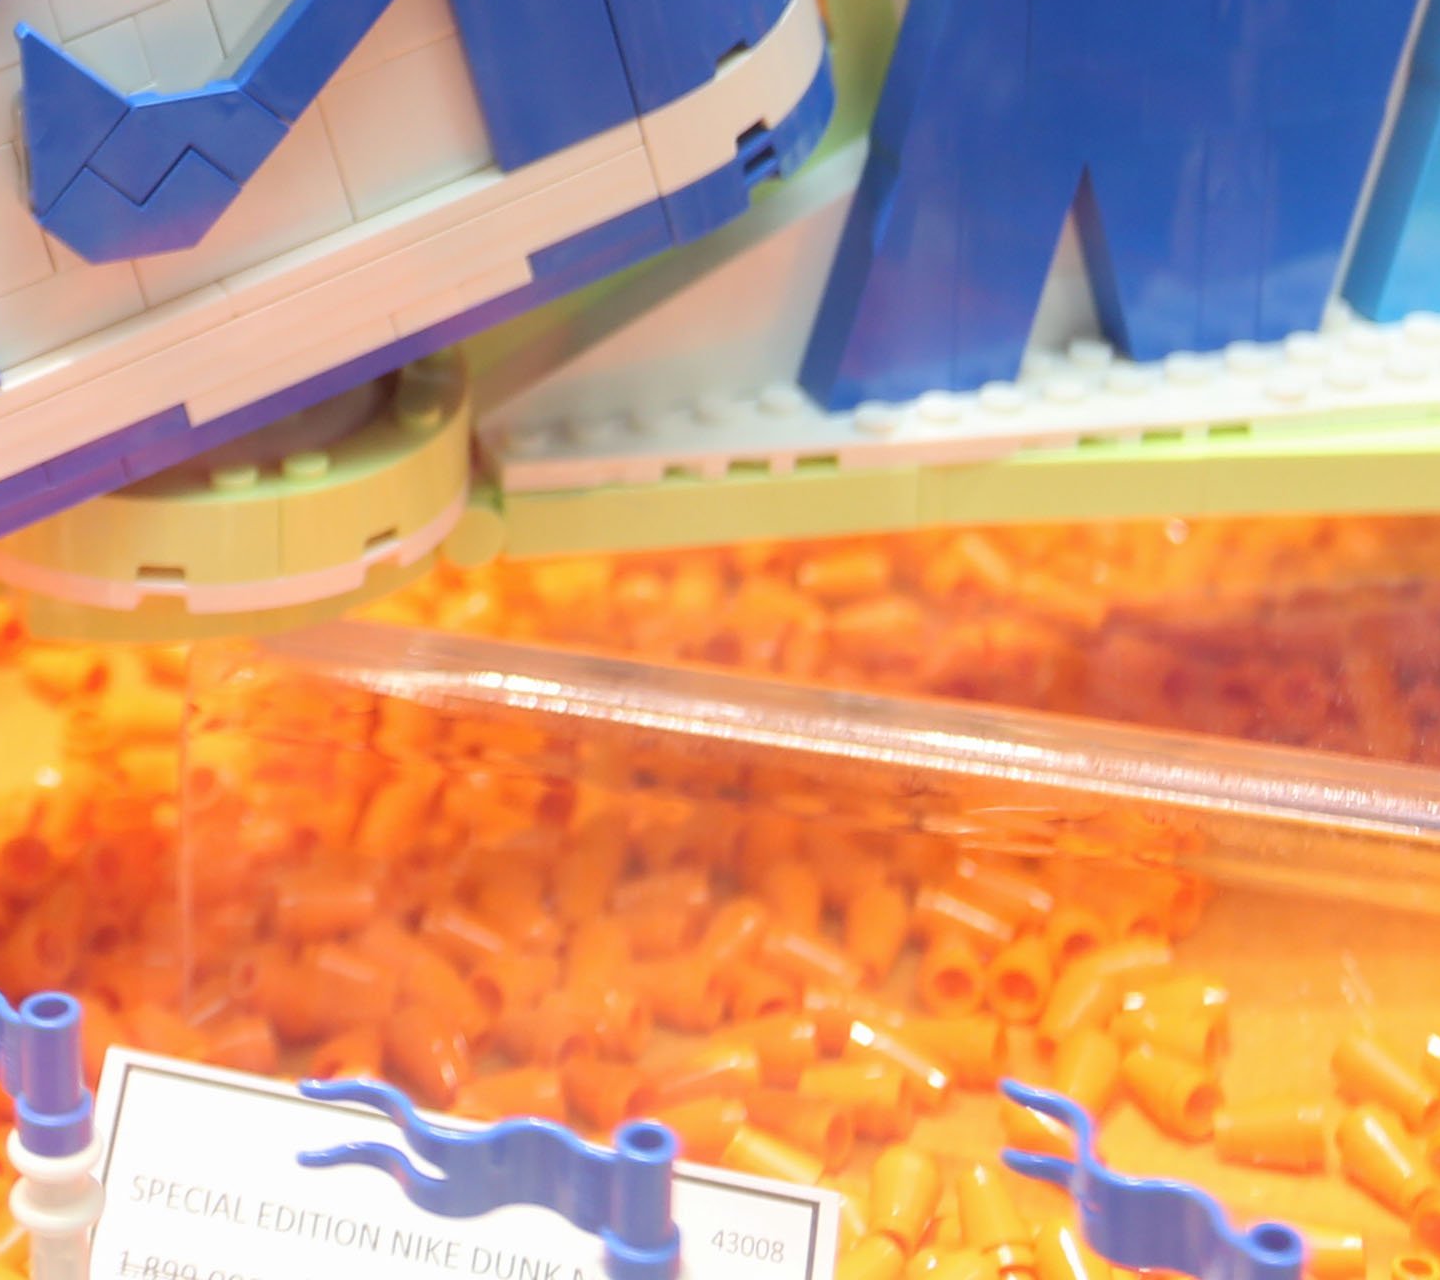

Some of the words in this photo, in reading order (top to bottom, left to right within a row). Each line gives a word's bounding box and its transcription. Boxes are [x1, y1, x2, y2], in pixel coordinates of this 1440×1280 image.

[130, 1175, 245, 1225] SPECIAL
[257, 1201, 381, 1251] EDITION
[390, 1230, 461, 1269] NIKE
[471, 1246, 562, 1280] DUNK
[711, 1229, 784, 1263] 43008
